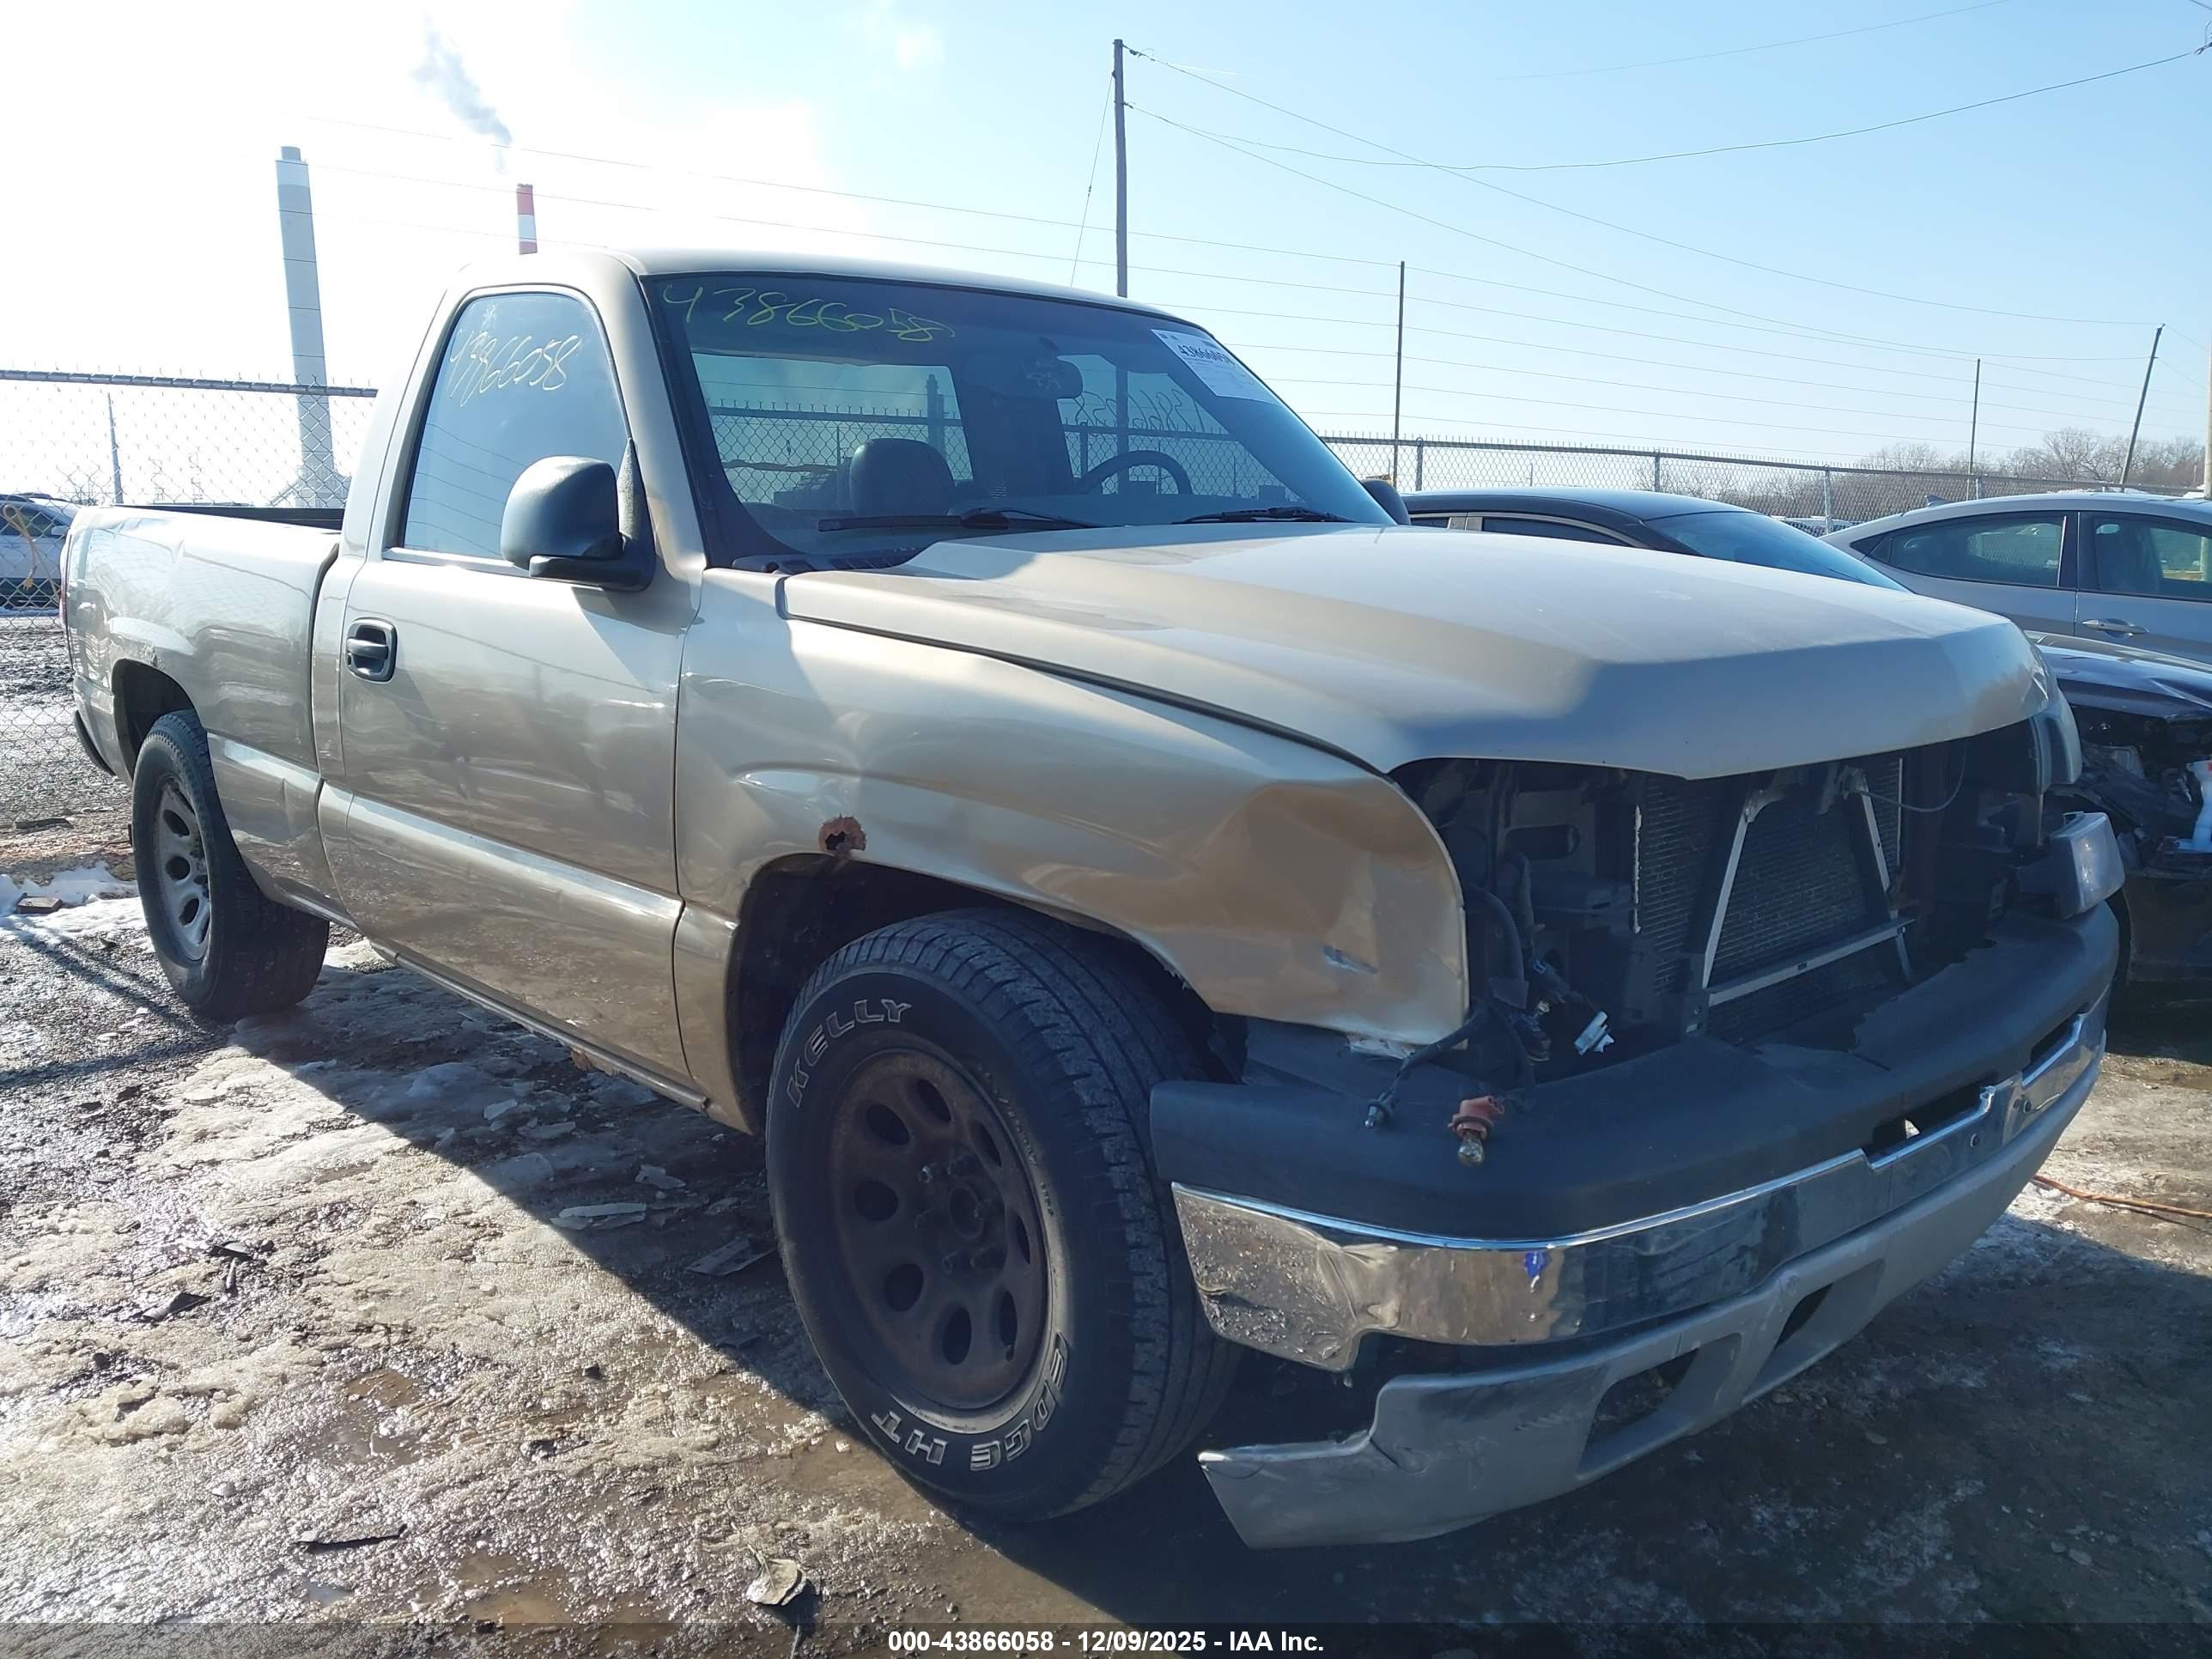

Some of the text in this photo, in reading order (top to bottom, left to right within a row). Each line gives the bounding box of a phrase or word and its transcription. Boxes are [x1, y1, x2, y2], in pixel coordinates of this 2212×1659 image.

[662, 284, 955, 342] 43866058
[787, 997, 913, 1109] KELLY
[871, 1330, 1068, 1472] EDGE HT
